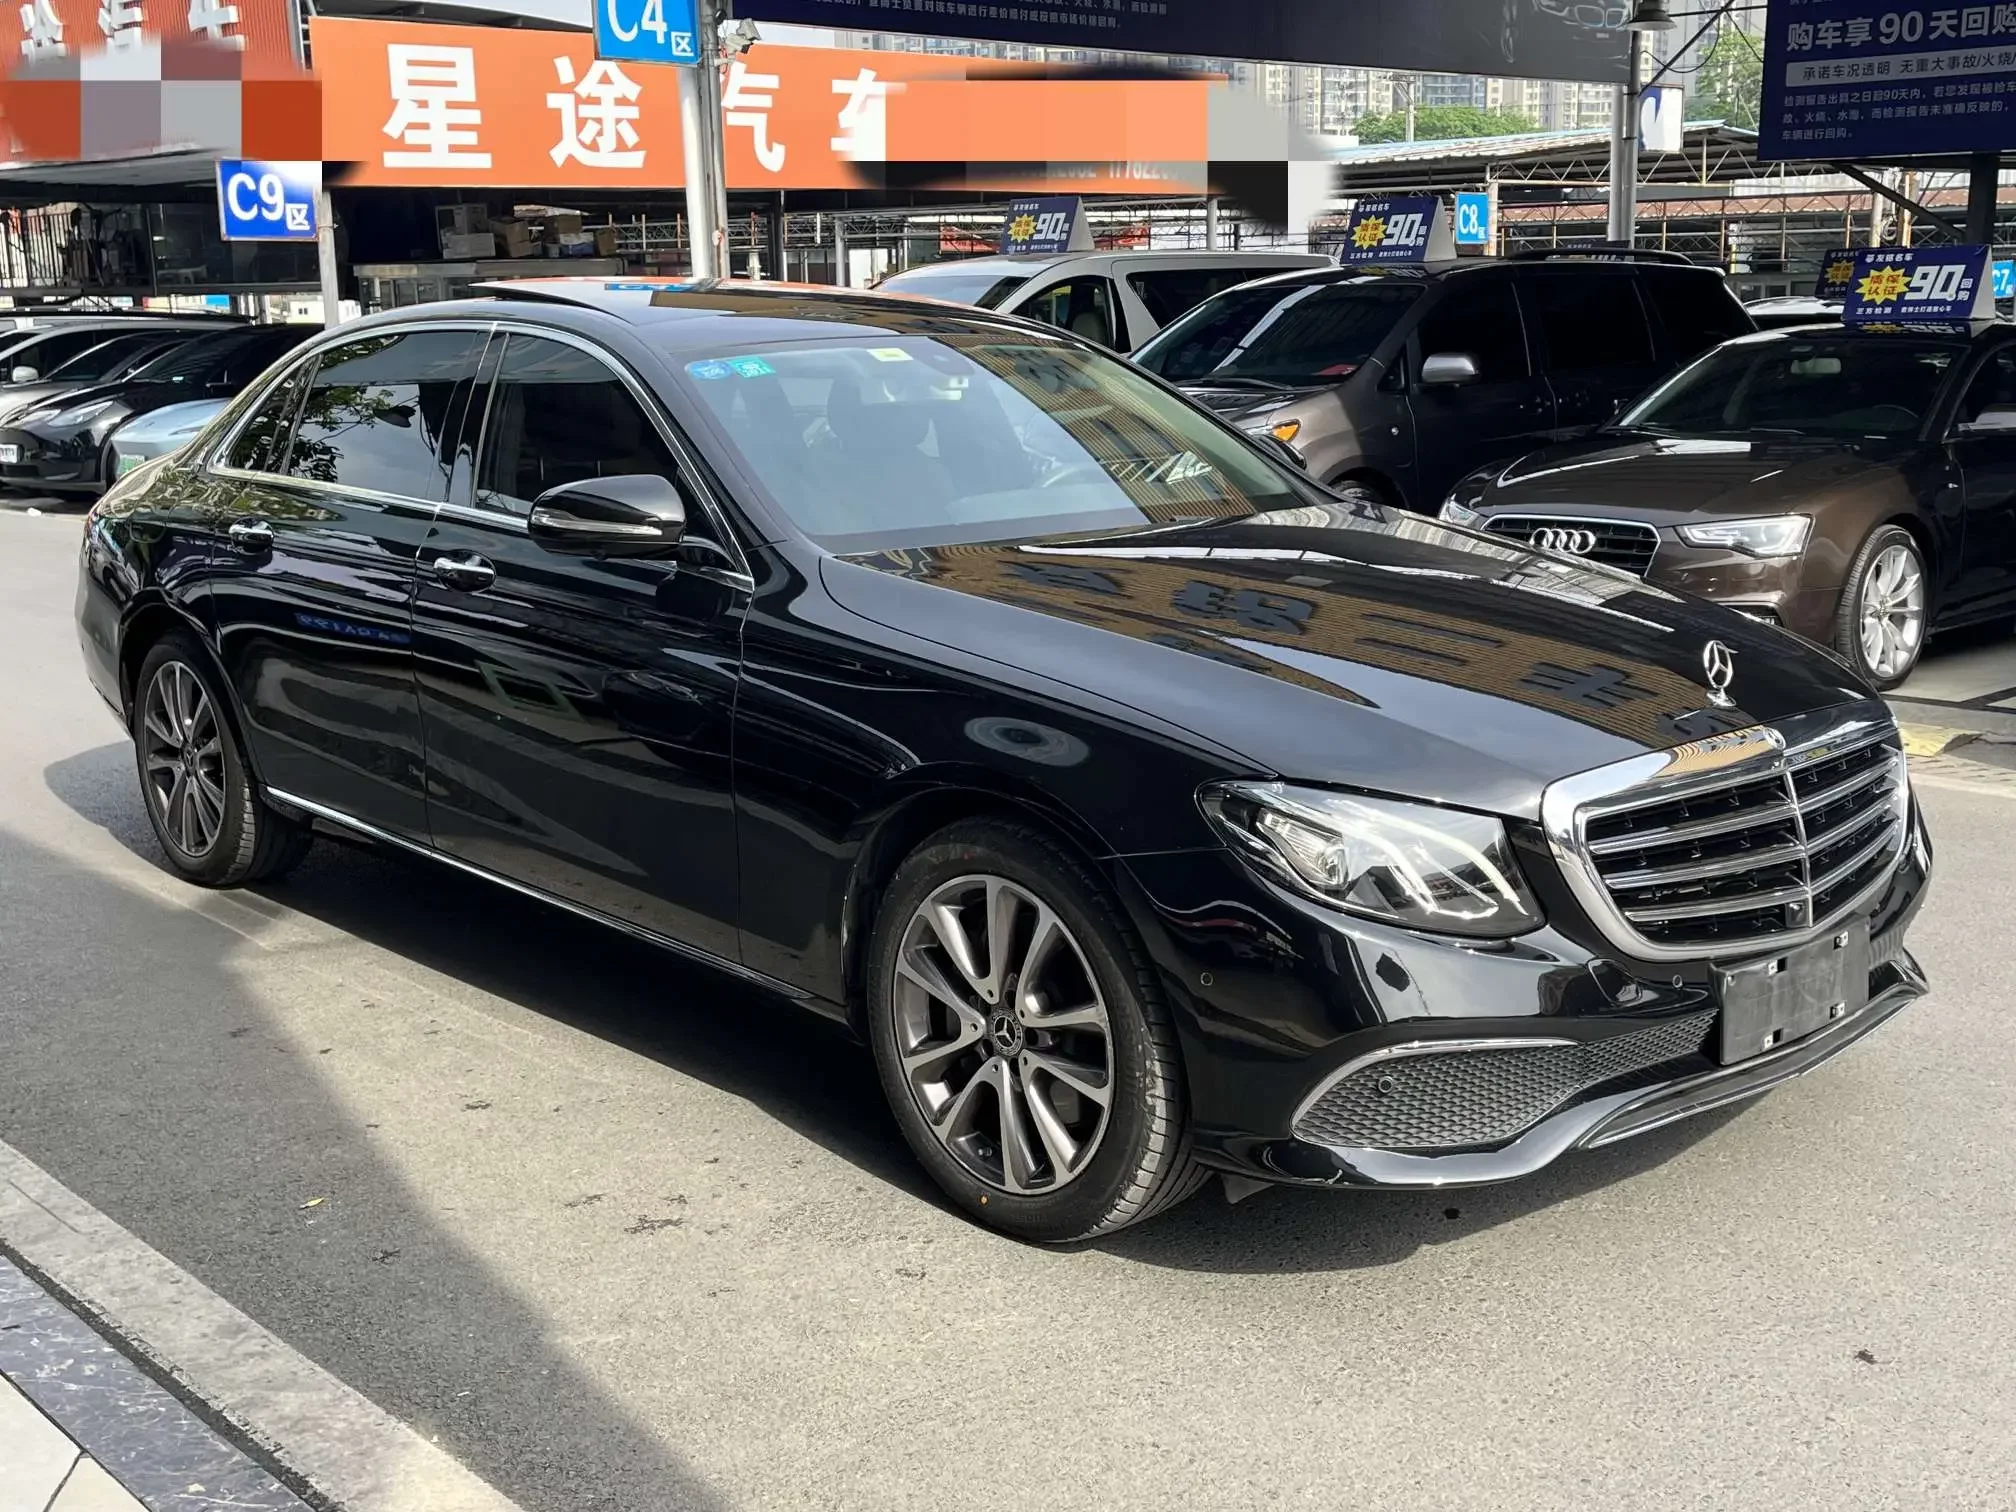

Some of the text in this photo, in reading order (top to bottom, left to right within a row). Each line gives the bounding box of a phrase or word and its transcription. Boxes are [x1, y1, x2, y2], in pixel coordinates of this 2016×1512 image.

[608, 0, 694, 56] C4区
[1803, 61, 1891, 81] 承诺车况透明
[227, 172, 311, 231] C9区
[1904, 264, 1966, 301] 90
